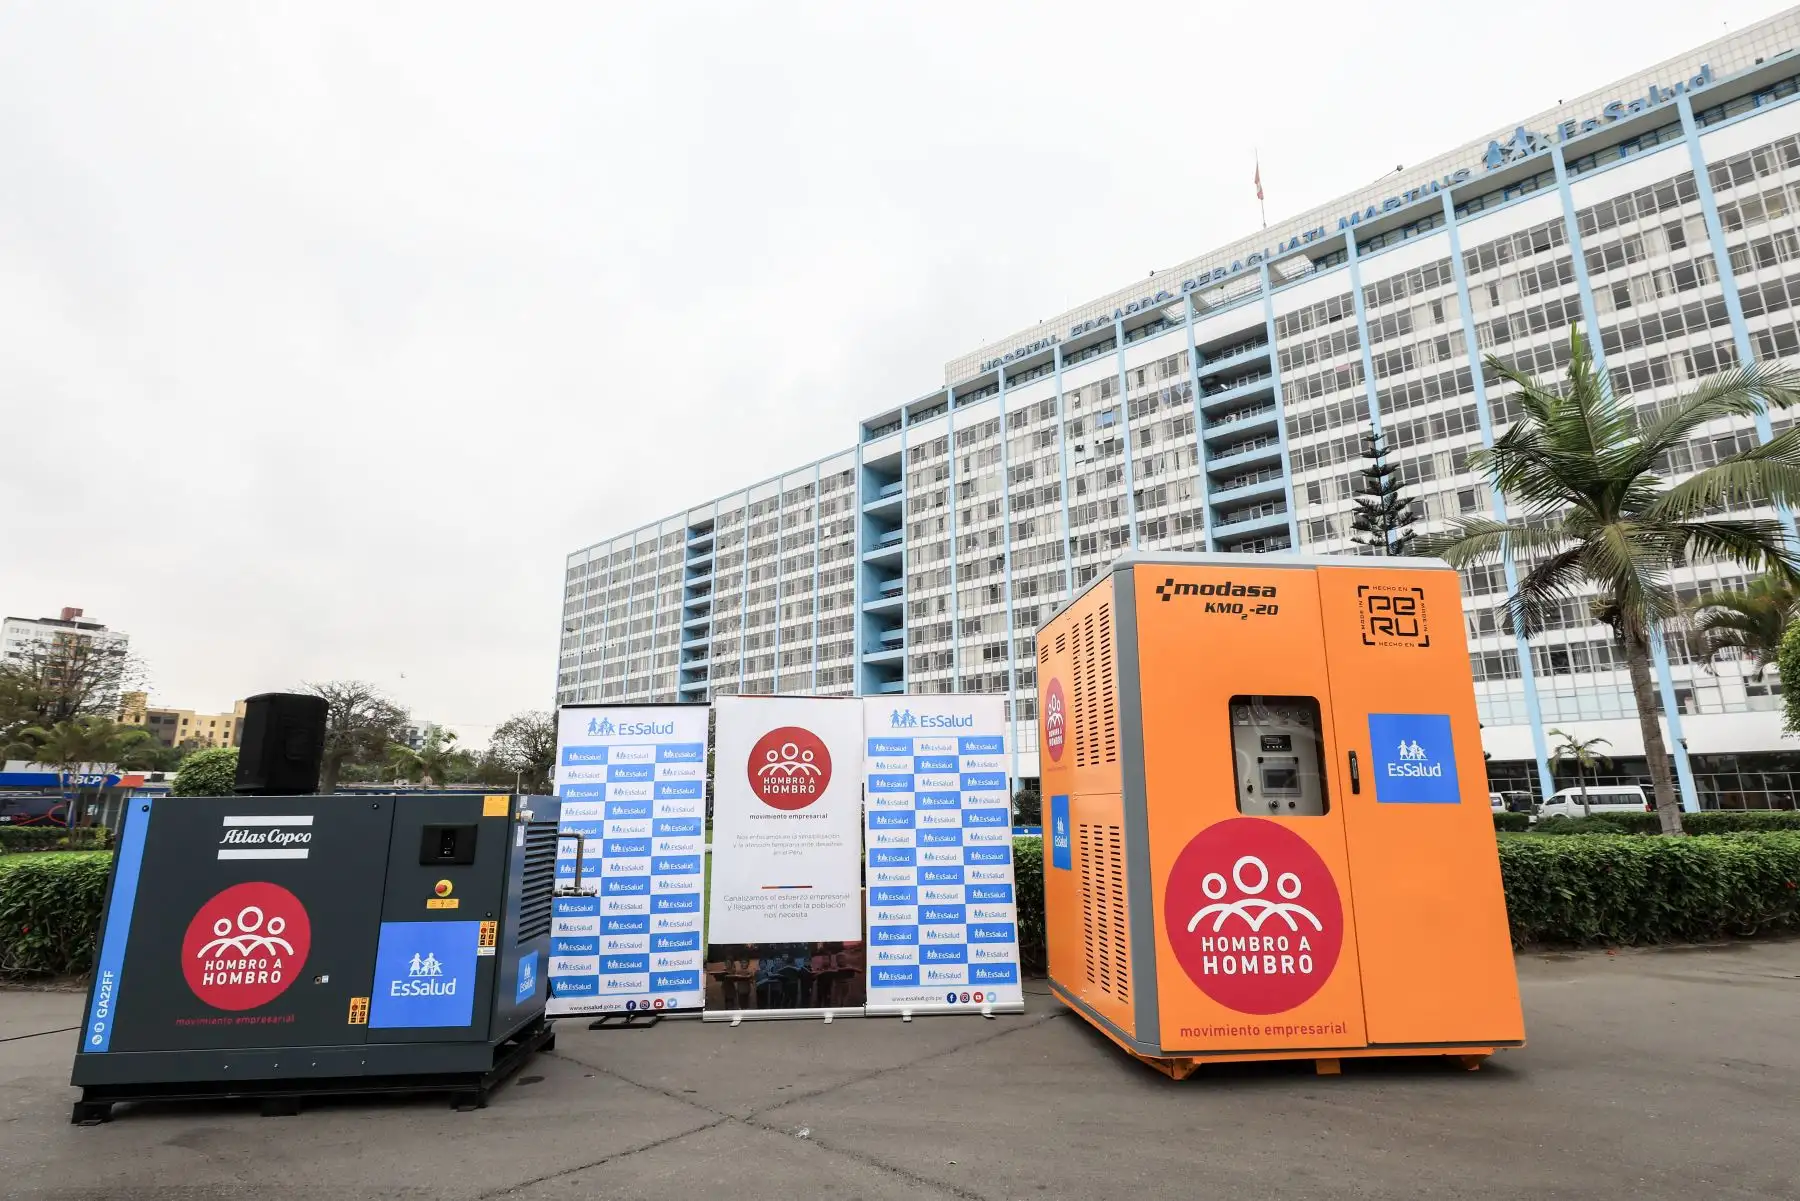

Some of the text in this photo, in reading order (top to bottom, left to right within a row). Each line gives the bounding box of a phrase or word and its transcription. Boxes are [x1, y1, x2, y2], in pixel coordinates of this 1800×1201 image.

[1174, 581, 1277, 598] modasa
[921, 714, 972, 727] EsSalud
[619, 722, 674, 735] EsSalud
[1388, 762, 1441, 776] EsSalud
[764, 785, 815, 794] HOMBRO
[219, 828, 312, 846] Atlas Copco
[1202, 936, 1311, 952] HOMBRO A
[204, 958, 282, 970] HOMBRO A
[1203, 954, 1313, 974] HOMBRO
[202, 970, 281, 985] HOMBRO
[96, 970, 114, 1018] GA22FF
[390, 978, 457, 996] EsSalud
[176, 1014, 295, 1026] movimiento empresarial
[1180, 1022, 1347, 1038] movimiento empresarial
